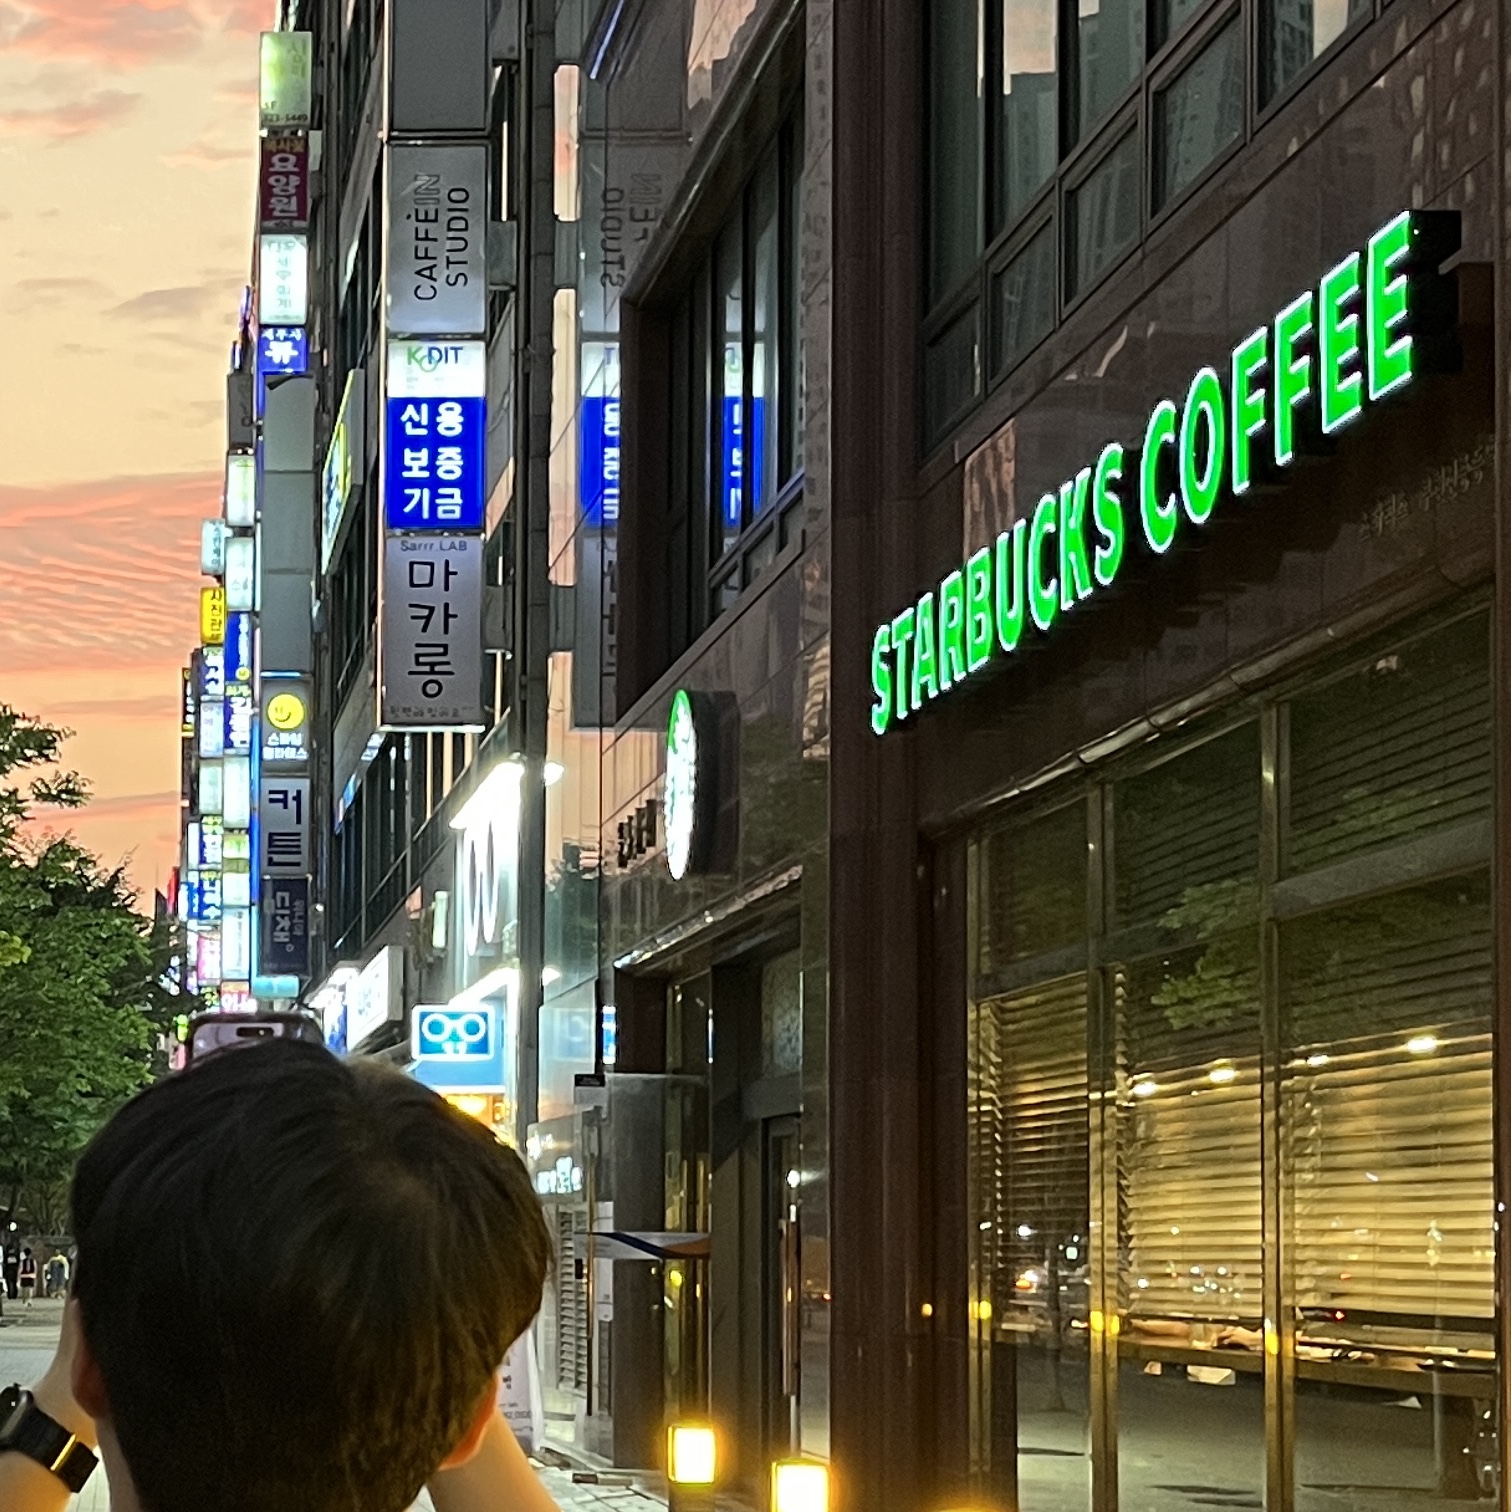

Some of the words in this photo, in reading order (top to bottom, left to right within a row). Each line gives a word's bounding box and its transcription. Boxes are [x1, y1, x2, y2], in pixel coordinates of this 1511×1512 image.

[446, 187, 470, 287] STUDIO
[407, 345, 463, 373] KODIT
[400, 402, 464, 437] 신용
[402, 446, 464, 480] 보증
[871, 442, 1125, 736] STARBUCKS
[1139, 209, 1414, 554] COFFEE
[403, 487, 463, 519] 기금
[407, 559, 459, 699] 마카롱
[267, 789, 302, 867] 커튼
